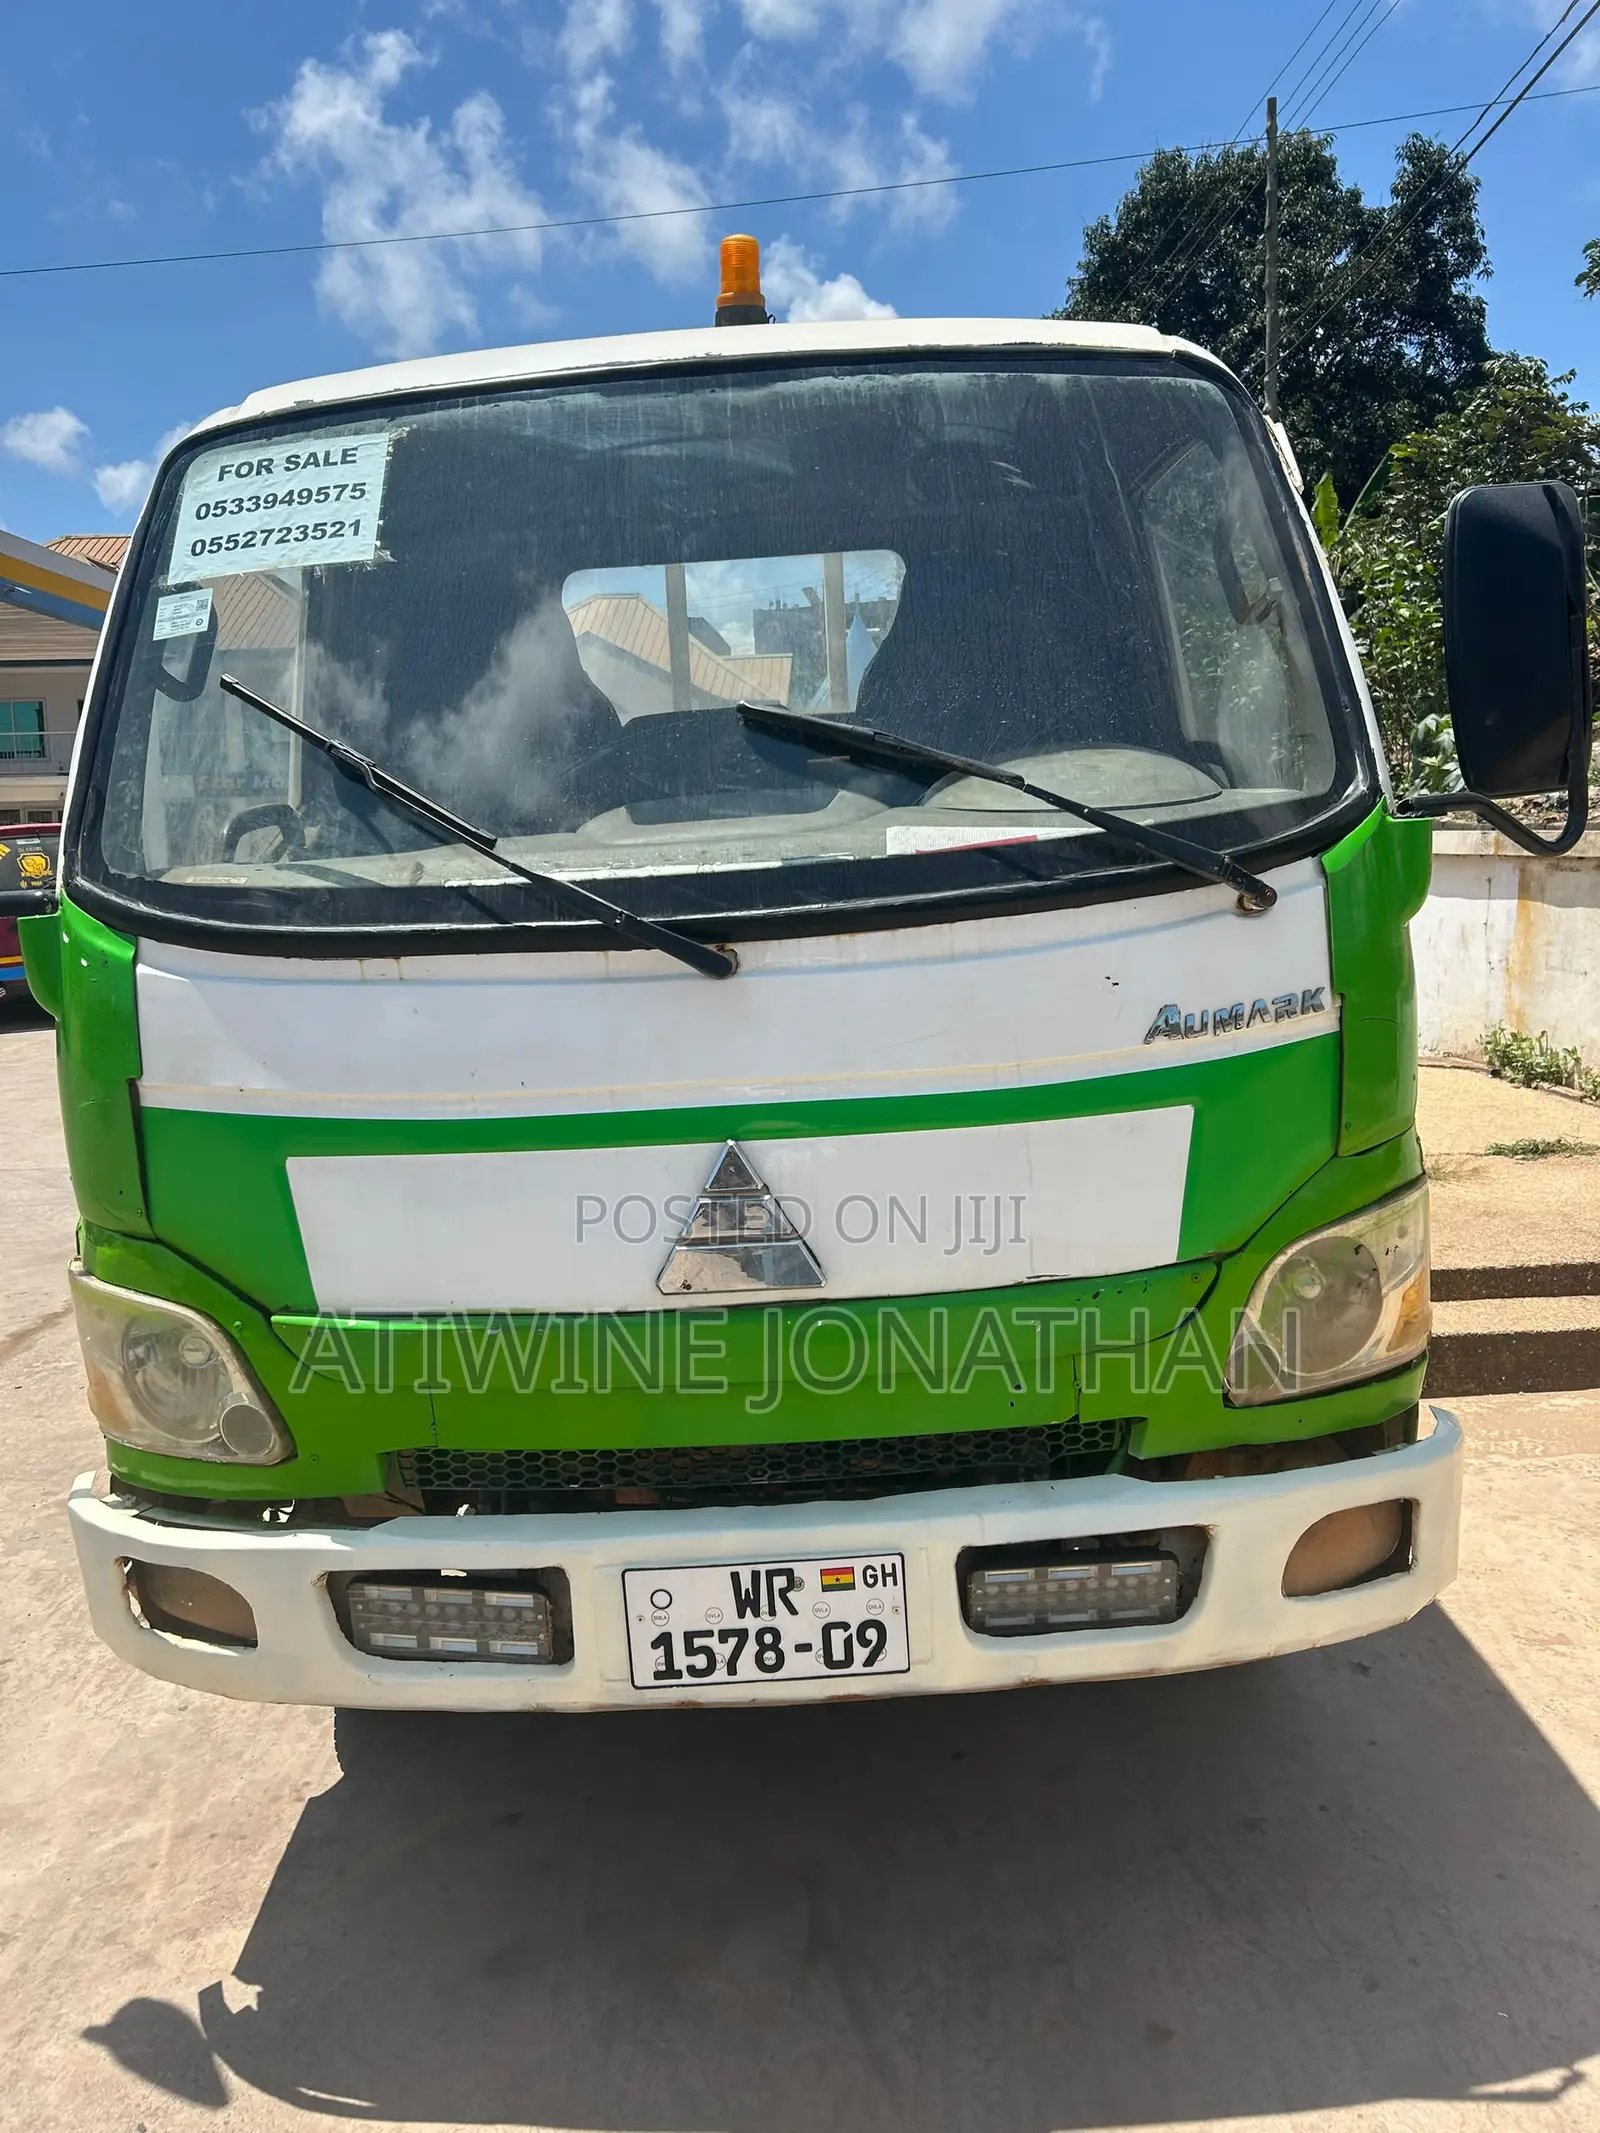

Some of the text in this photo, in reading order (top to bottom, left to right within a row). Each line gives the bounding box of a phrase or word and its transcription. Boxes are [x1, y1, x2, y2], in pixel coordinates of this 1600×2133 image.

[217, 447, 359, 482] FOR SALE
[195, 482, 367, 521] 0533949575
[190, 519, 362, 557] 0552723521
[1143, 986, 1326, 1045] AUMARK
[729, 1567, 799, 1620] WR
[861, 1562, 898, 1589] GH
[649, 1618, 888, 1681] 1578-09
